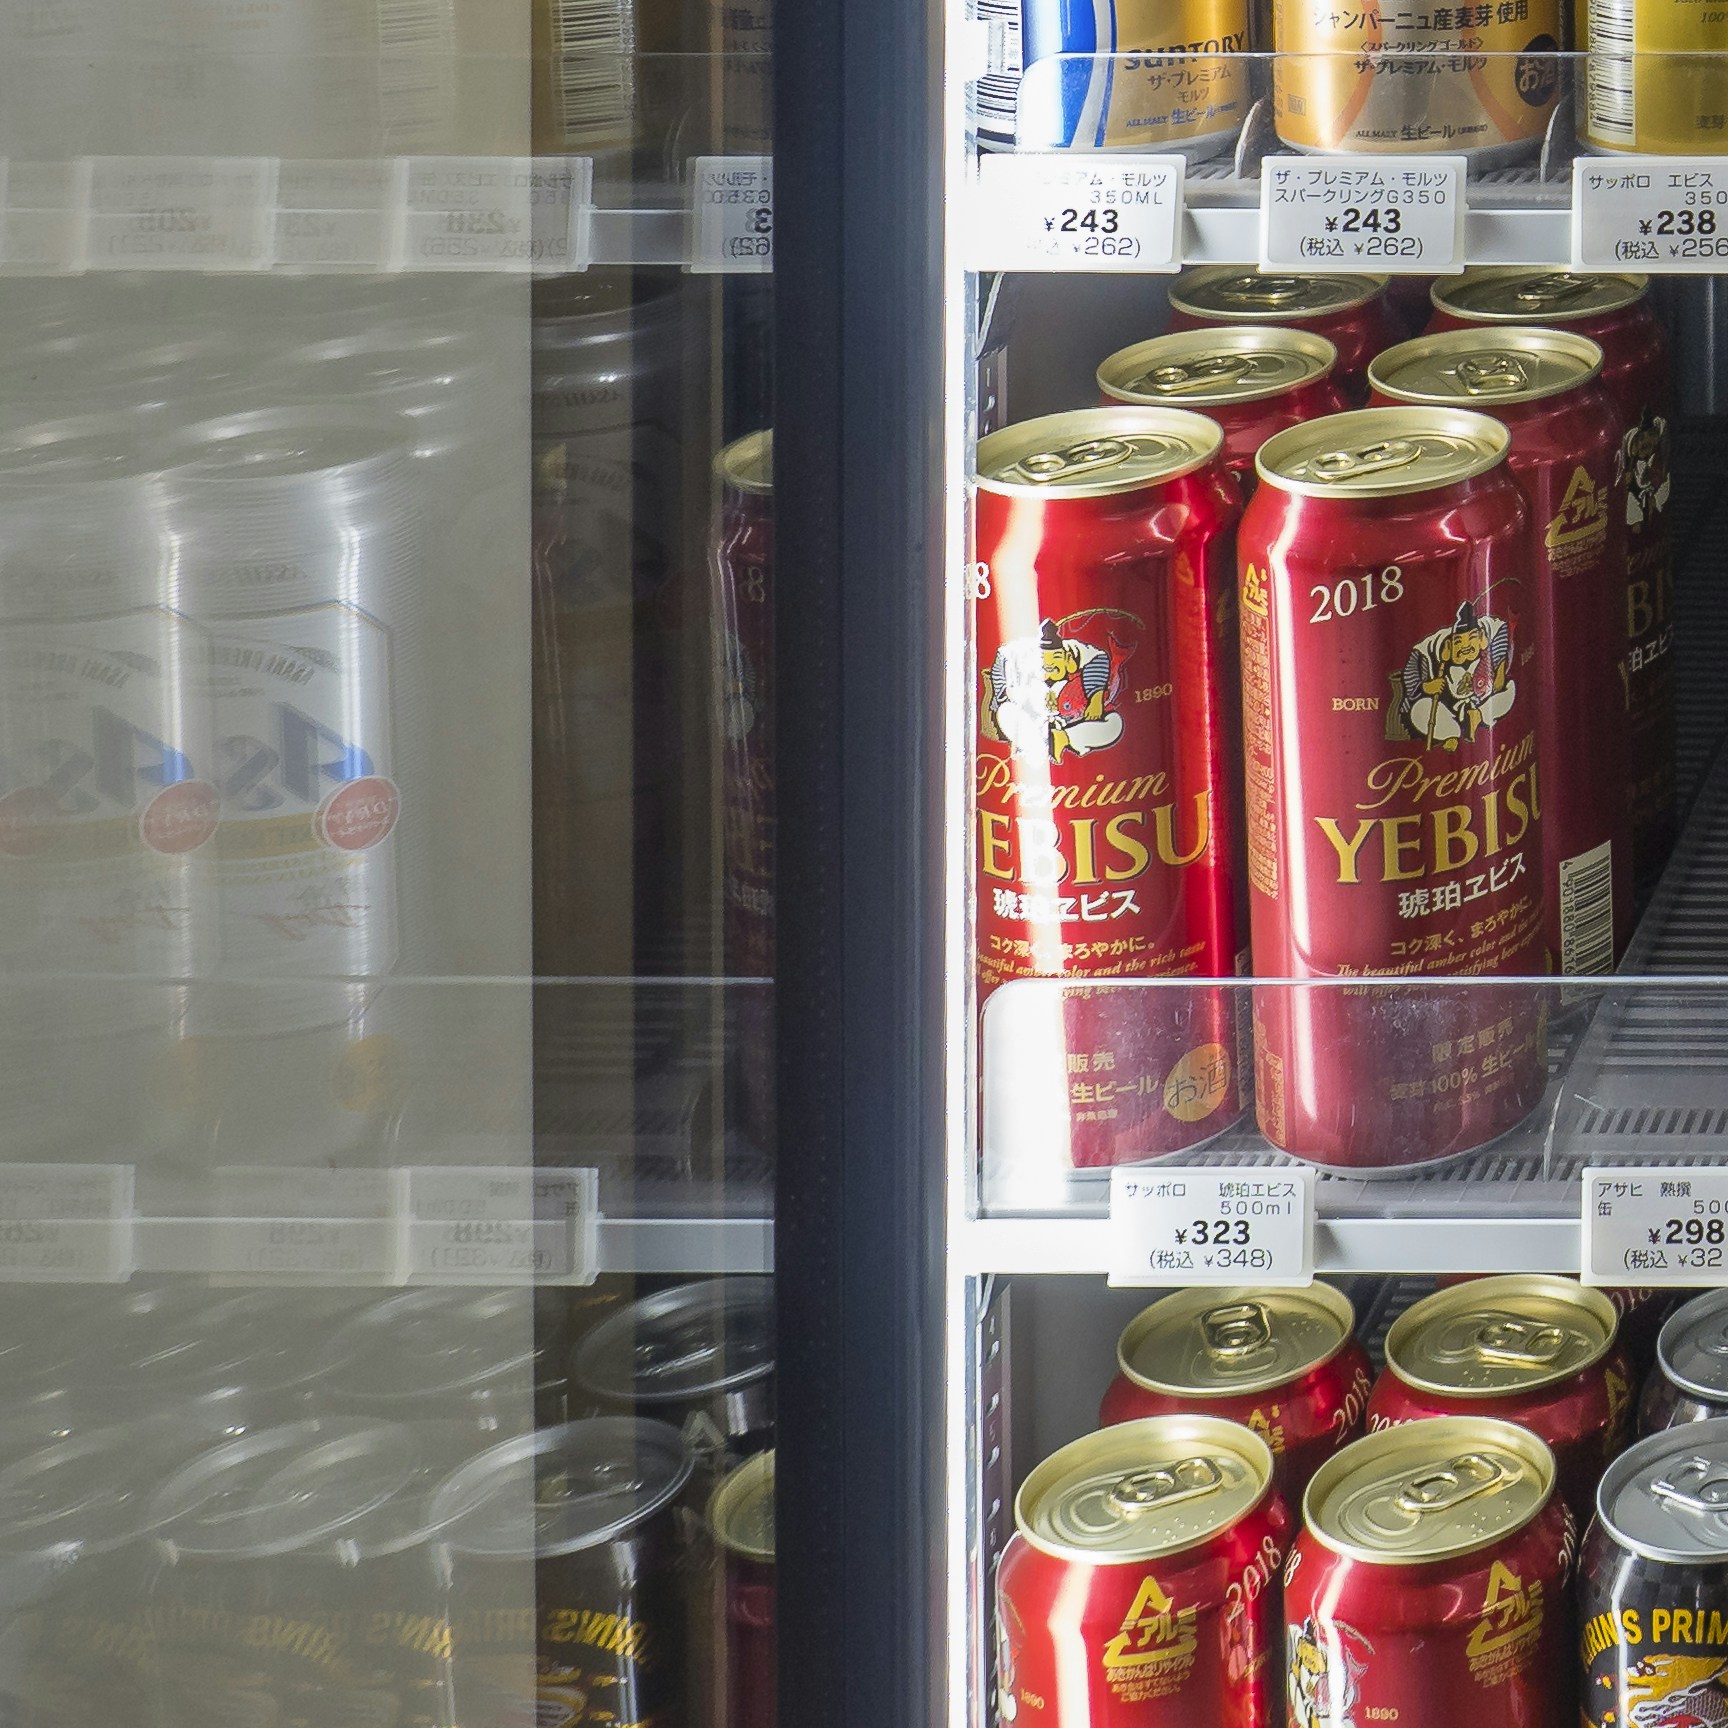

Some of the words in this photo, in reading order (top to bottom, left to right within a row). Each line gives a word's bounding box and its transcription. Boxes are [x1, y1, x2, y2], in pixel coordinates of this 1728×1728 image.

[1043, 208, 1120, 234] ¥243
[1324, 207, 1402, 234] ¥243
[1638, 209, 1717, 236] ¥238
[1308, 566, 1406, 624] 2018
[1134, 682, 1174, 704] 1890
[1330, 696, 1380, 714] BORN
[1174, 1219, 1251, 1246] ¥323
[1647, 1218, 1726, 1245] ¥298
[1226, 1536, 1284, 1622] 2018
[1364, 1706, 1400, 1722] 1890
